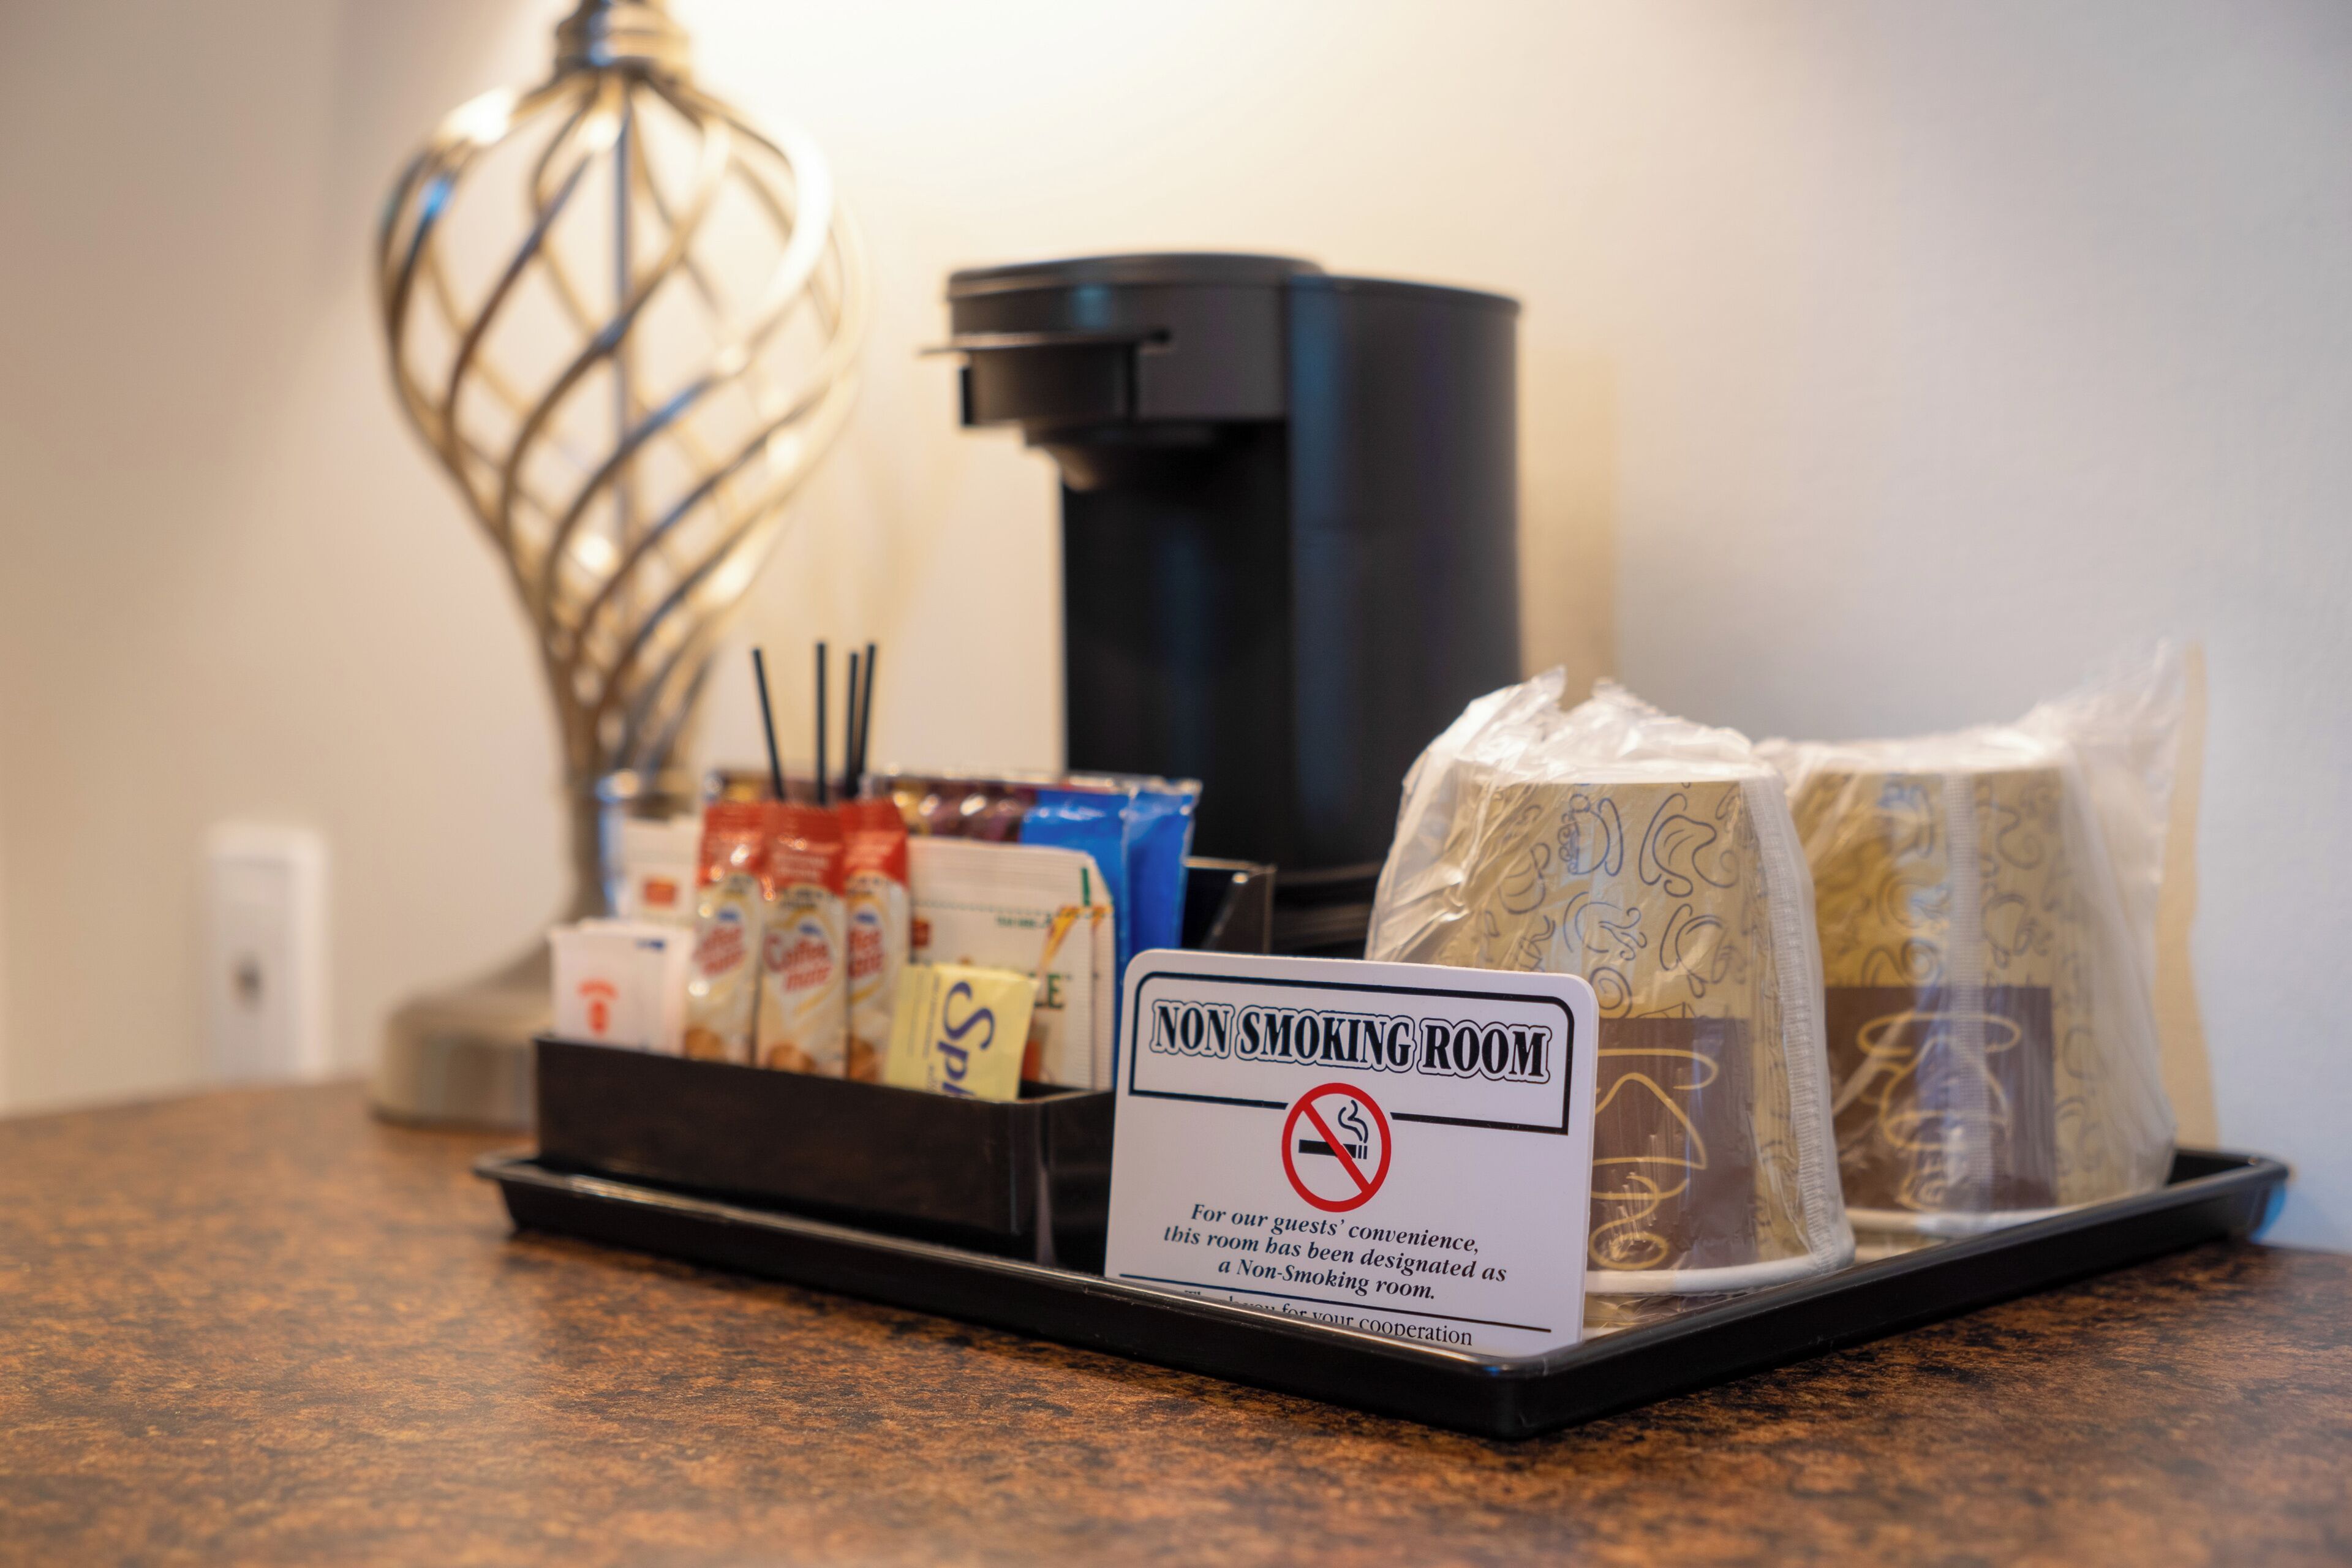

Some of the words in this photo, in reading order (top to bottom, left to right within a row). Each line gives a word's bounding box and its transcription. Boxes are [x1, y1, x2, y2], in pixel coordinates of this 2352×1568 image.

[1152, 1001, 1233, 1058] NON
[1236, 1006, 1415, 1071] SMOKING
[1419, 1019, 1550, 1083] ROOM
[1164, 1226, 1200, 1245] this
[1207, 1234, 1259, 1252] room
[1265, 1237, 1302, 1257] has
[1307, 1242, 1354, 1263] been
[1360, 1248, 1477, 1279] designated
[1481, 1266, 1507, 1282] as
[1191, 1204, 1226, 1222] For
[1231, 1212, 1268, 1227] our
[1348, 1225, 1479, 1255] convenience,
[1218, 1261, 1231, 1274] a
[1236, 1259, 1370, 1297] Non-Smoking
[1375, 1280, 1434, 1300] room.
[1359, 1318, 1472, 1346] cooperation
